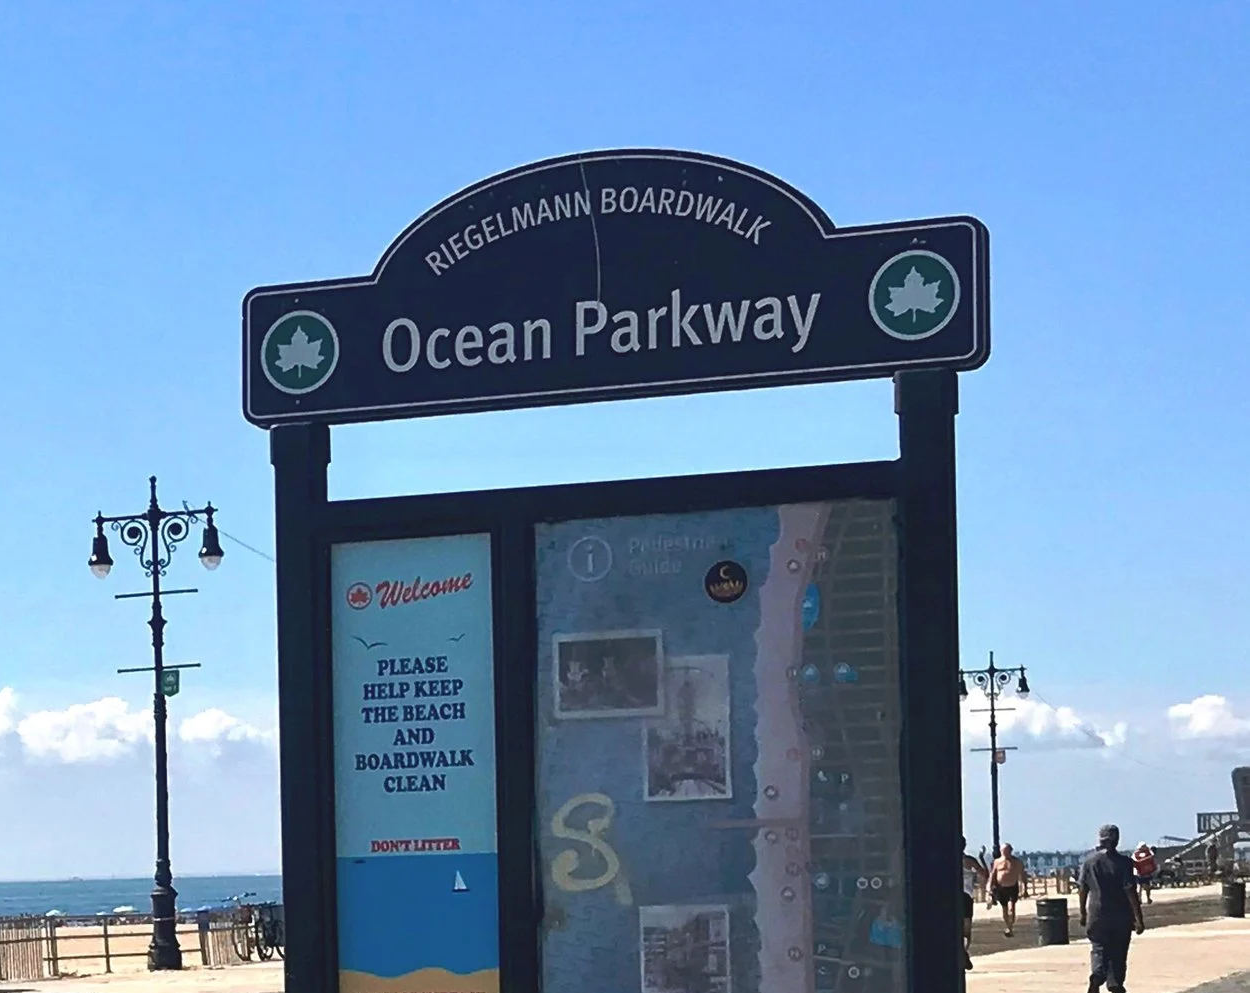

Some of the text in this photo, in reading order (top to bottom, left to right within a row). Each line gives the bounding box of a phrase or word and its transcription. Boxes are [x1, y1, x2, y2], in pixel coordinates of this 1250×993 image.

[424, 187, 772, 276] RIEGELMANN BOARDWALK
[382, 288, 821, 372] Ocean Parkway
[629, 533, 731, 555] Pedestri
[375, 572, 474, 609] Welcome
[377, 656, 448, 676] PLEASE
[363, 679, 464, 700] HELP KEEP
[361, 702, 466, 724] THE BEACH
[393, 727, 435, 746] AND
[355, 750, 475, 770] BOARDWALK
[383, 774, 446, 793] CLEAN
[413, 838, 461, 851] LITTER
